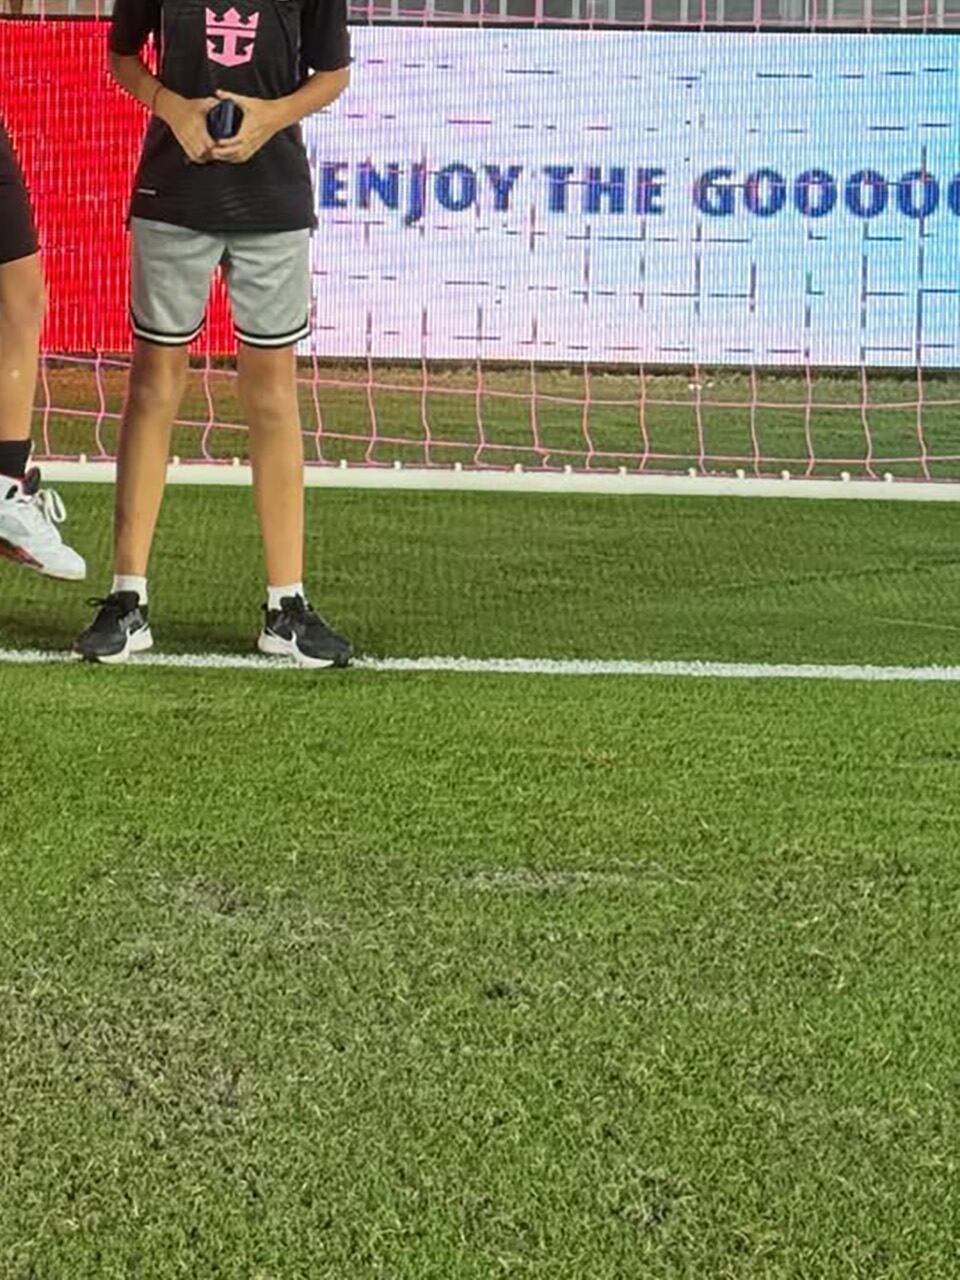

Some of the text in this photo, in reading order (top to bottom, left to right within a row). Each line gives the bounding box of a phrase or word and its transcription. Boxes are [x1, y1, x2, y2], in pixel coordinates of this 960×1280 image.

[319, 161, 960, 227] ENJOY THE GOOOO
